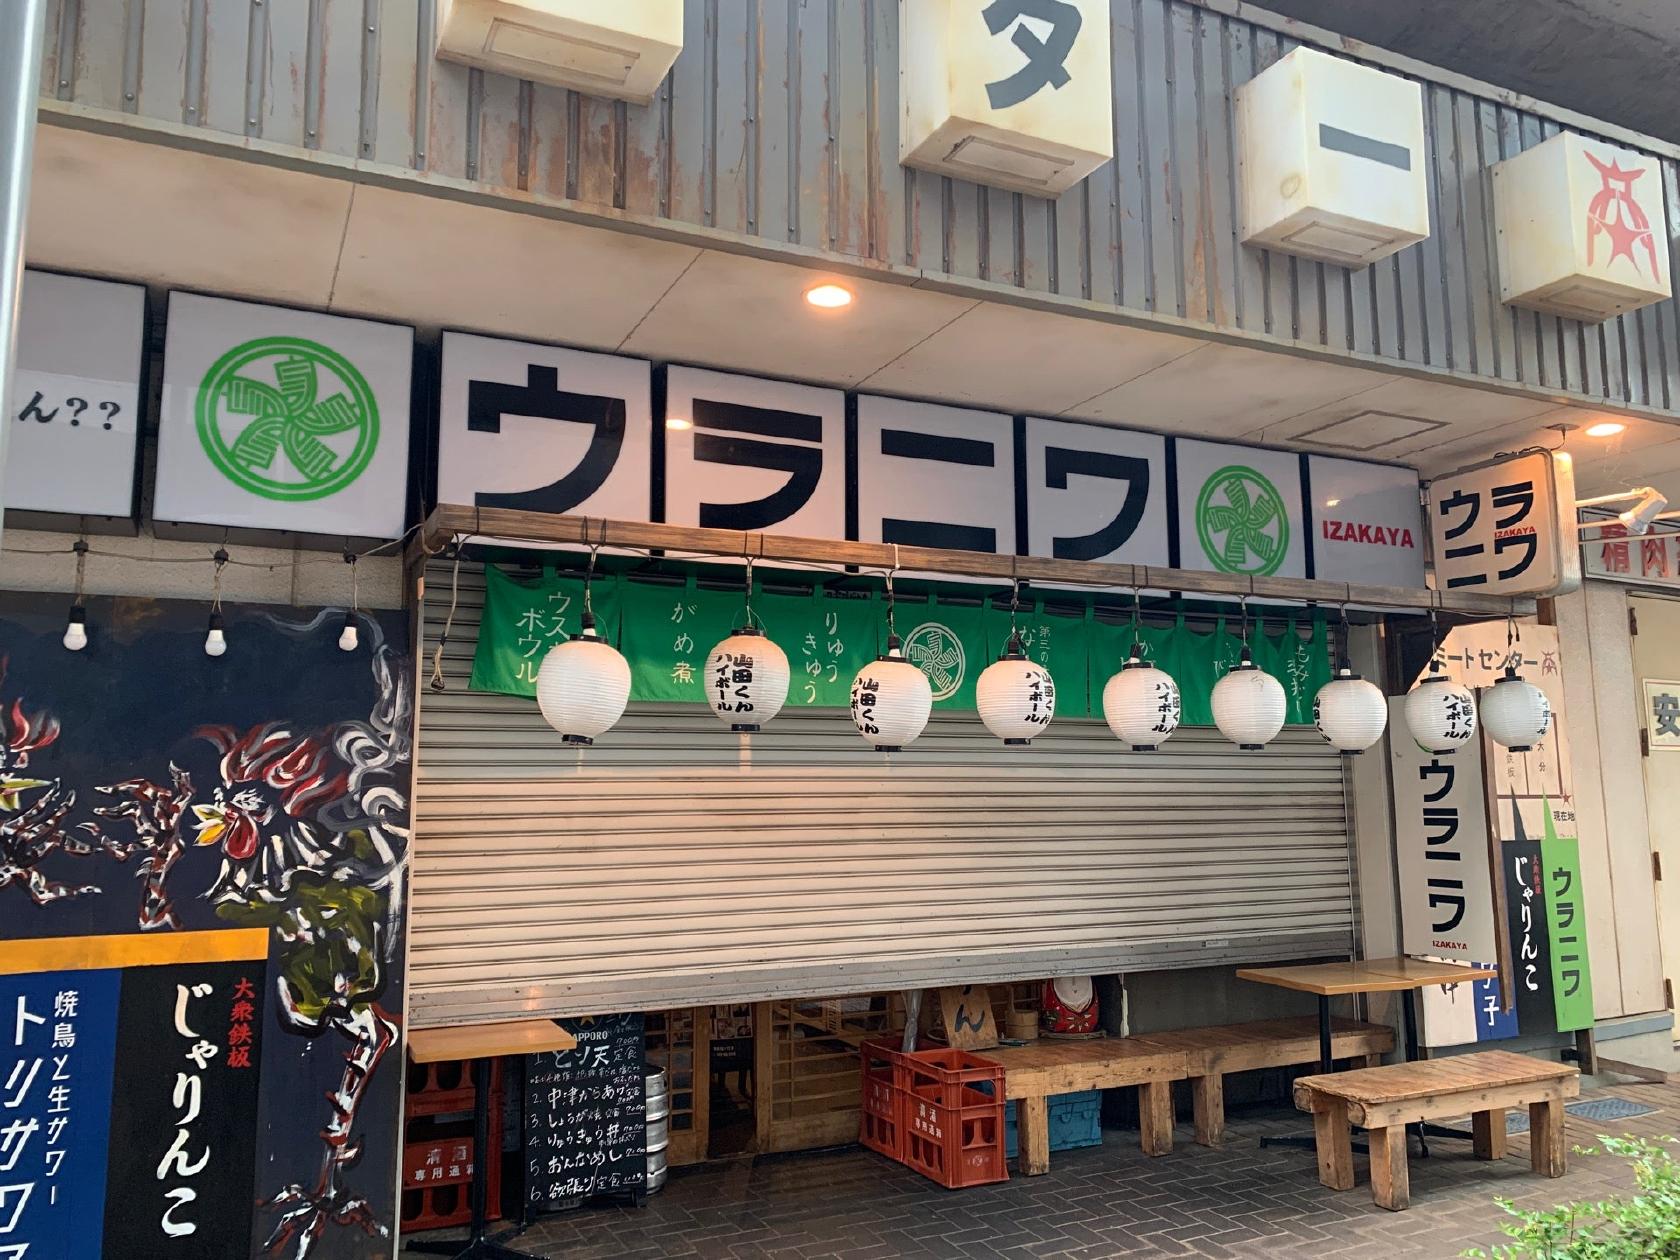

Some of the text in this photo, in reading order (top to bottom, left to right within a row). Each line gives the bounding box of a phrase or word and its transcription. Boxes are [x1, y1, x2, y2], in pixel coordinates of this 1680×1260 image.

[467, 363, 1149, 562] ウラニワ
[1323, 520, 1414, 548] IZAKAYA
[1494, 526, 1536, 538] IZAKAYA
[515, 608, 546, 684] ボウル
[545, 592, 570, 652] ウス
[670, 602, 697, 684] がめ煮
[825, 612, 844, 683] りゅう
[714, 653, 733, 712] ハイボール
[732, 653, 754, 713] 山田くん
[802, 632, 822, 703] きゅう
[1024, 671, 1043, 723] ハイボール
[859, 677, 880, 735] 山田くん
[1151, 682, 1172, 733] ハイボール
[1443, 694, 1462, 739] ハイボール
[1418, 759, 1466, 932] ウラニワ
[1432, 940, 1468, 951] IZAKAYA
[1514, 856, 1539, 992] じゃりんこ
[1552, 867, 1581, 998] ウラニワ
[0, 995, 46, 1260] トリサワ
[46, 990, 79, 1205] 焼鳥と生サワー
[156, 983, 219, 1238] じゃりんこ
